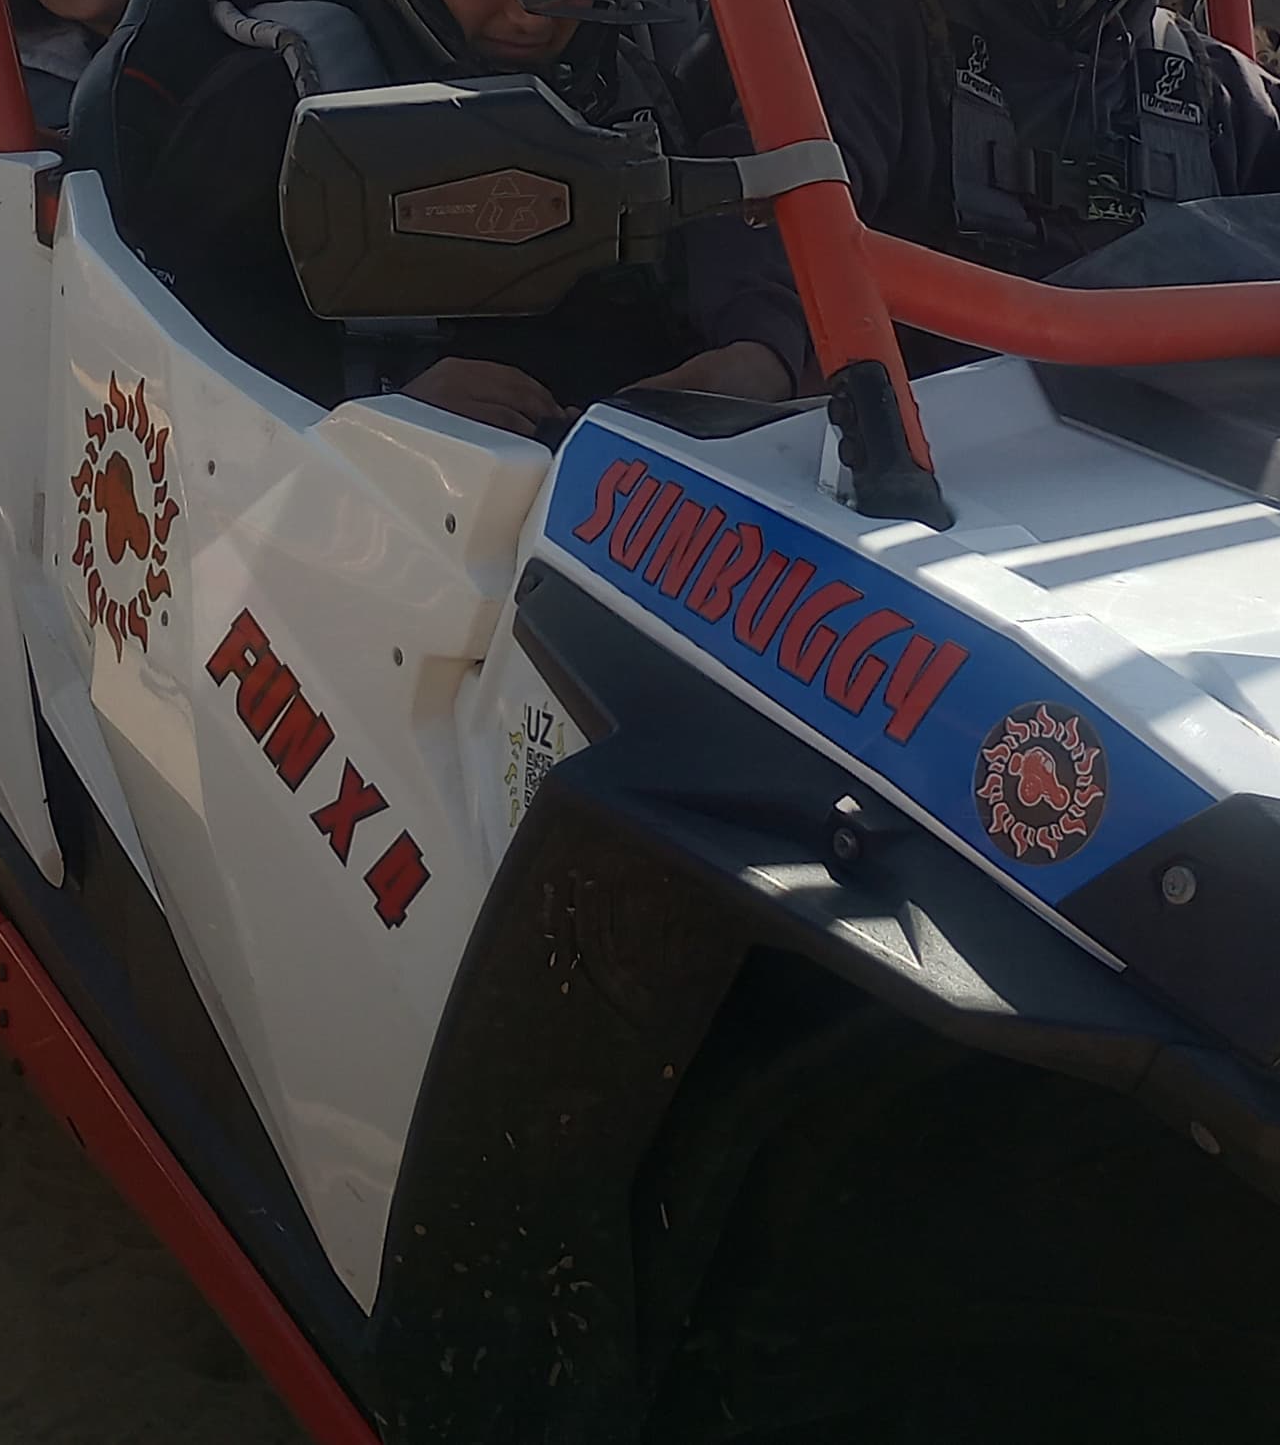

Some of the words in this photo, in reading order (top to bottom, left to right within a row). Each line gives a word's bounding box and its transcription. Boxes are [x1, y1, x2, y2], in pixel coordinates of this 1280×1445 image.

[205, 607, 336, 794] FUN
[309, 756, 391, 868] X
[571, 458, 970, 744] SUNBUGGY
